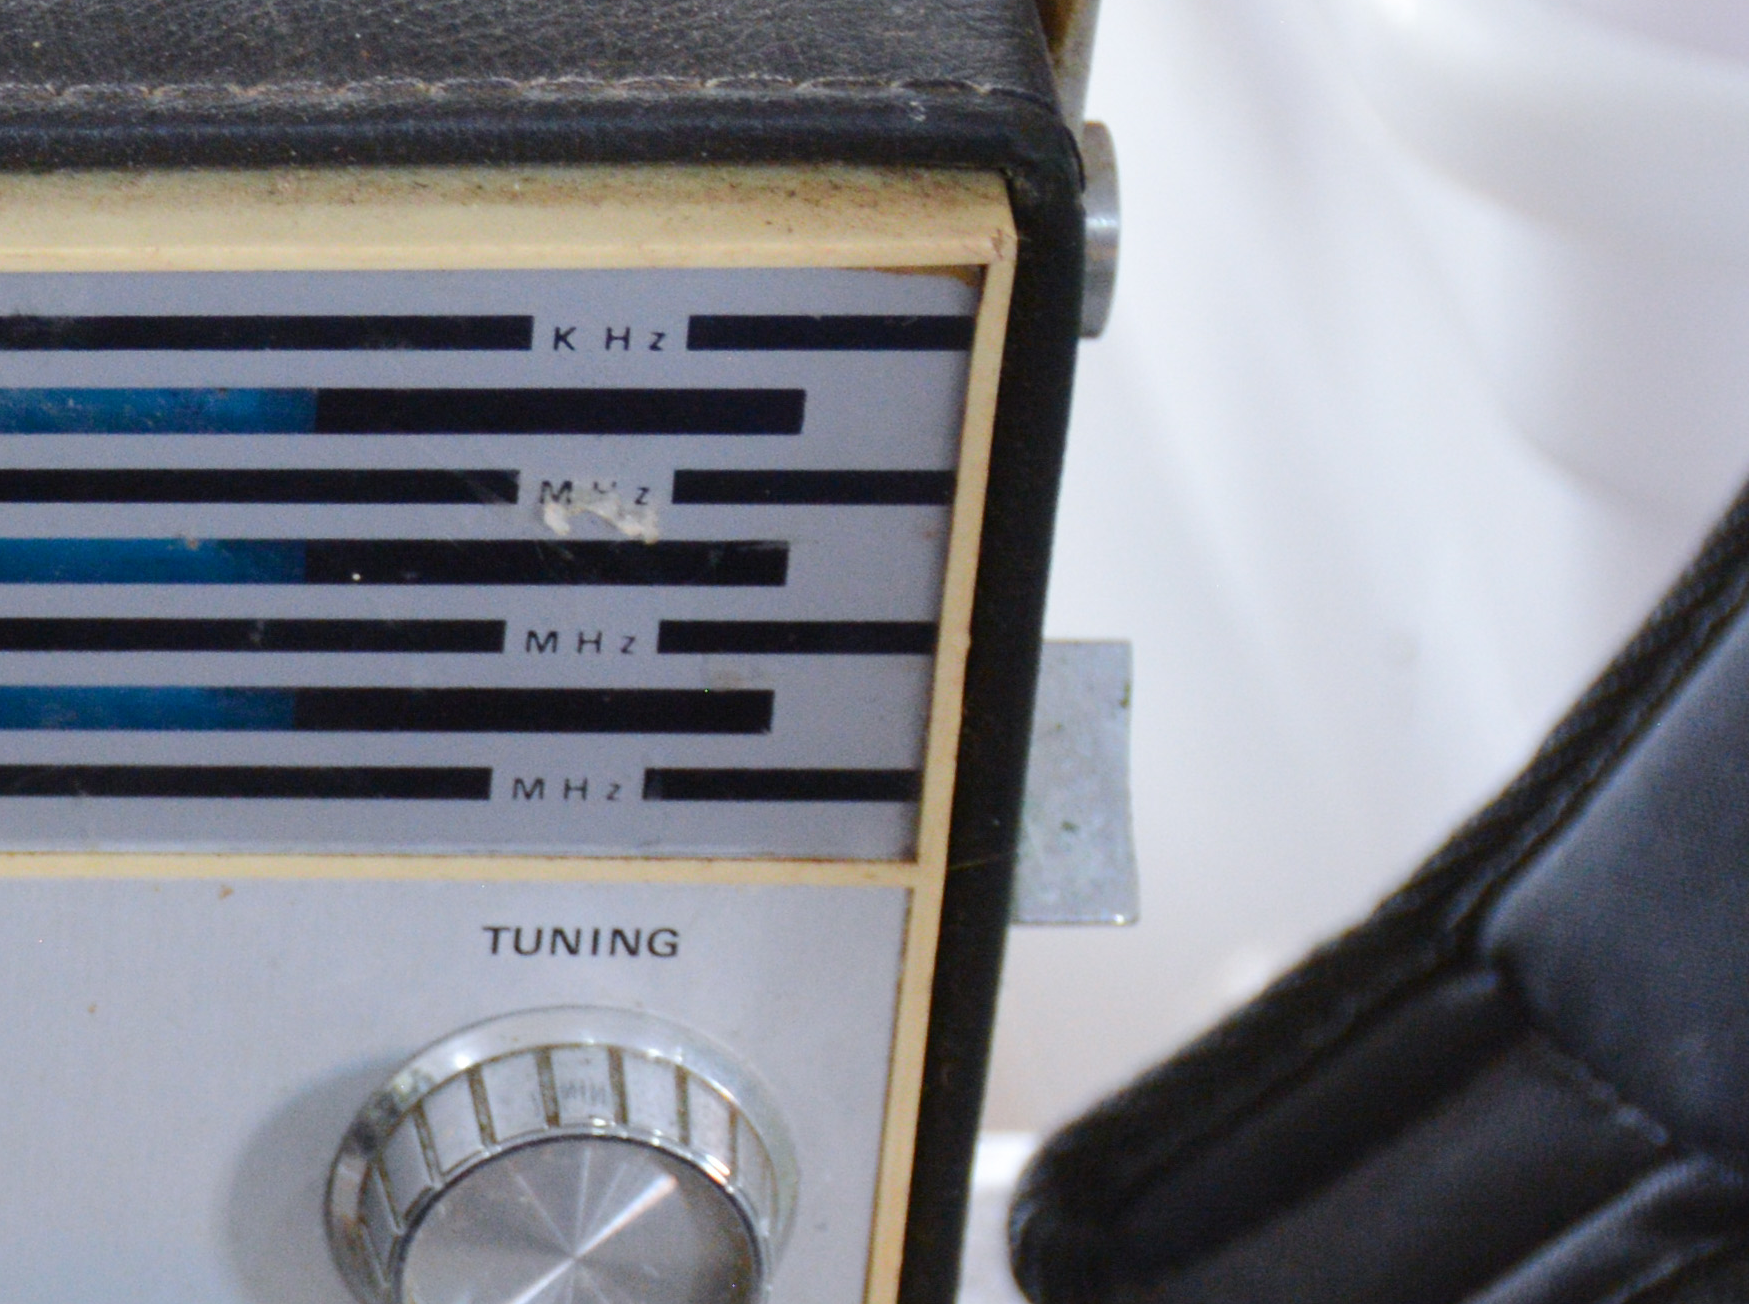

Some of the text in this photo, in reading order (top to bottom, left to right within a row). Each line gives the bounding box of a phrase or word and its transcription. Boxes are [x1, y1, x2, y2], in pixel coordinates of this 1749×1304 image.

[524, 629, 636, 655] MHz
[512, 777, 621, 802] MHz
[483, 926, 679, 958] TUNING
